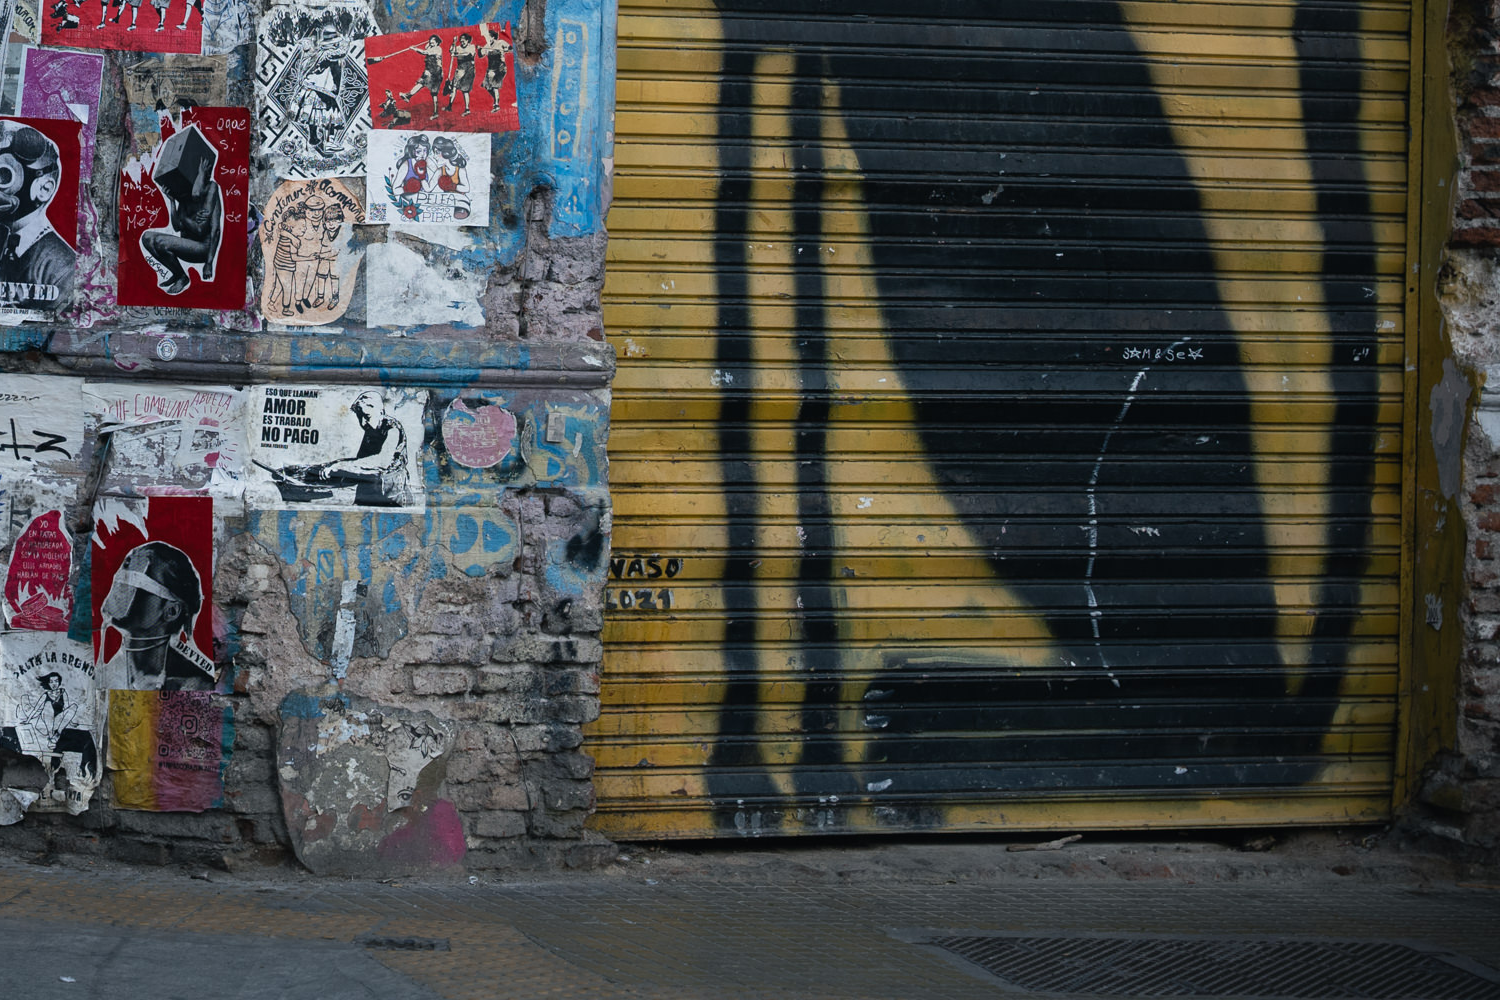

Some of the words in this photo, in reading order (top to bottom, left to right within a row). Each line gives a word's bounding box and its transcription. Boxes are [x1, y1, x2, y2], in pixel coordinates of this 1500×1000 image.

[265, 387, 278, 397] ESO
[279, 388, 291, 398] QUE
[292, 389, 318, 399] LLAMAN
[263, 397, 306, 416] AMOR
[262, 414, 273, 425] ES
[274, 415, 312, 428] TRABAJO
[261, 426, 282, 442] NO
[283, 428, 320, 445] PAGO
[175, 641, 213, 673] DEVYED
